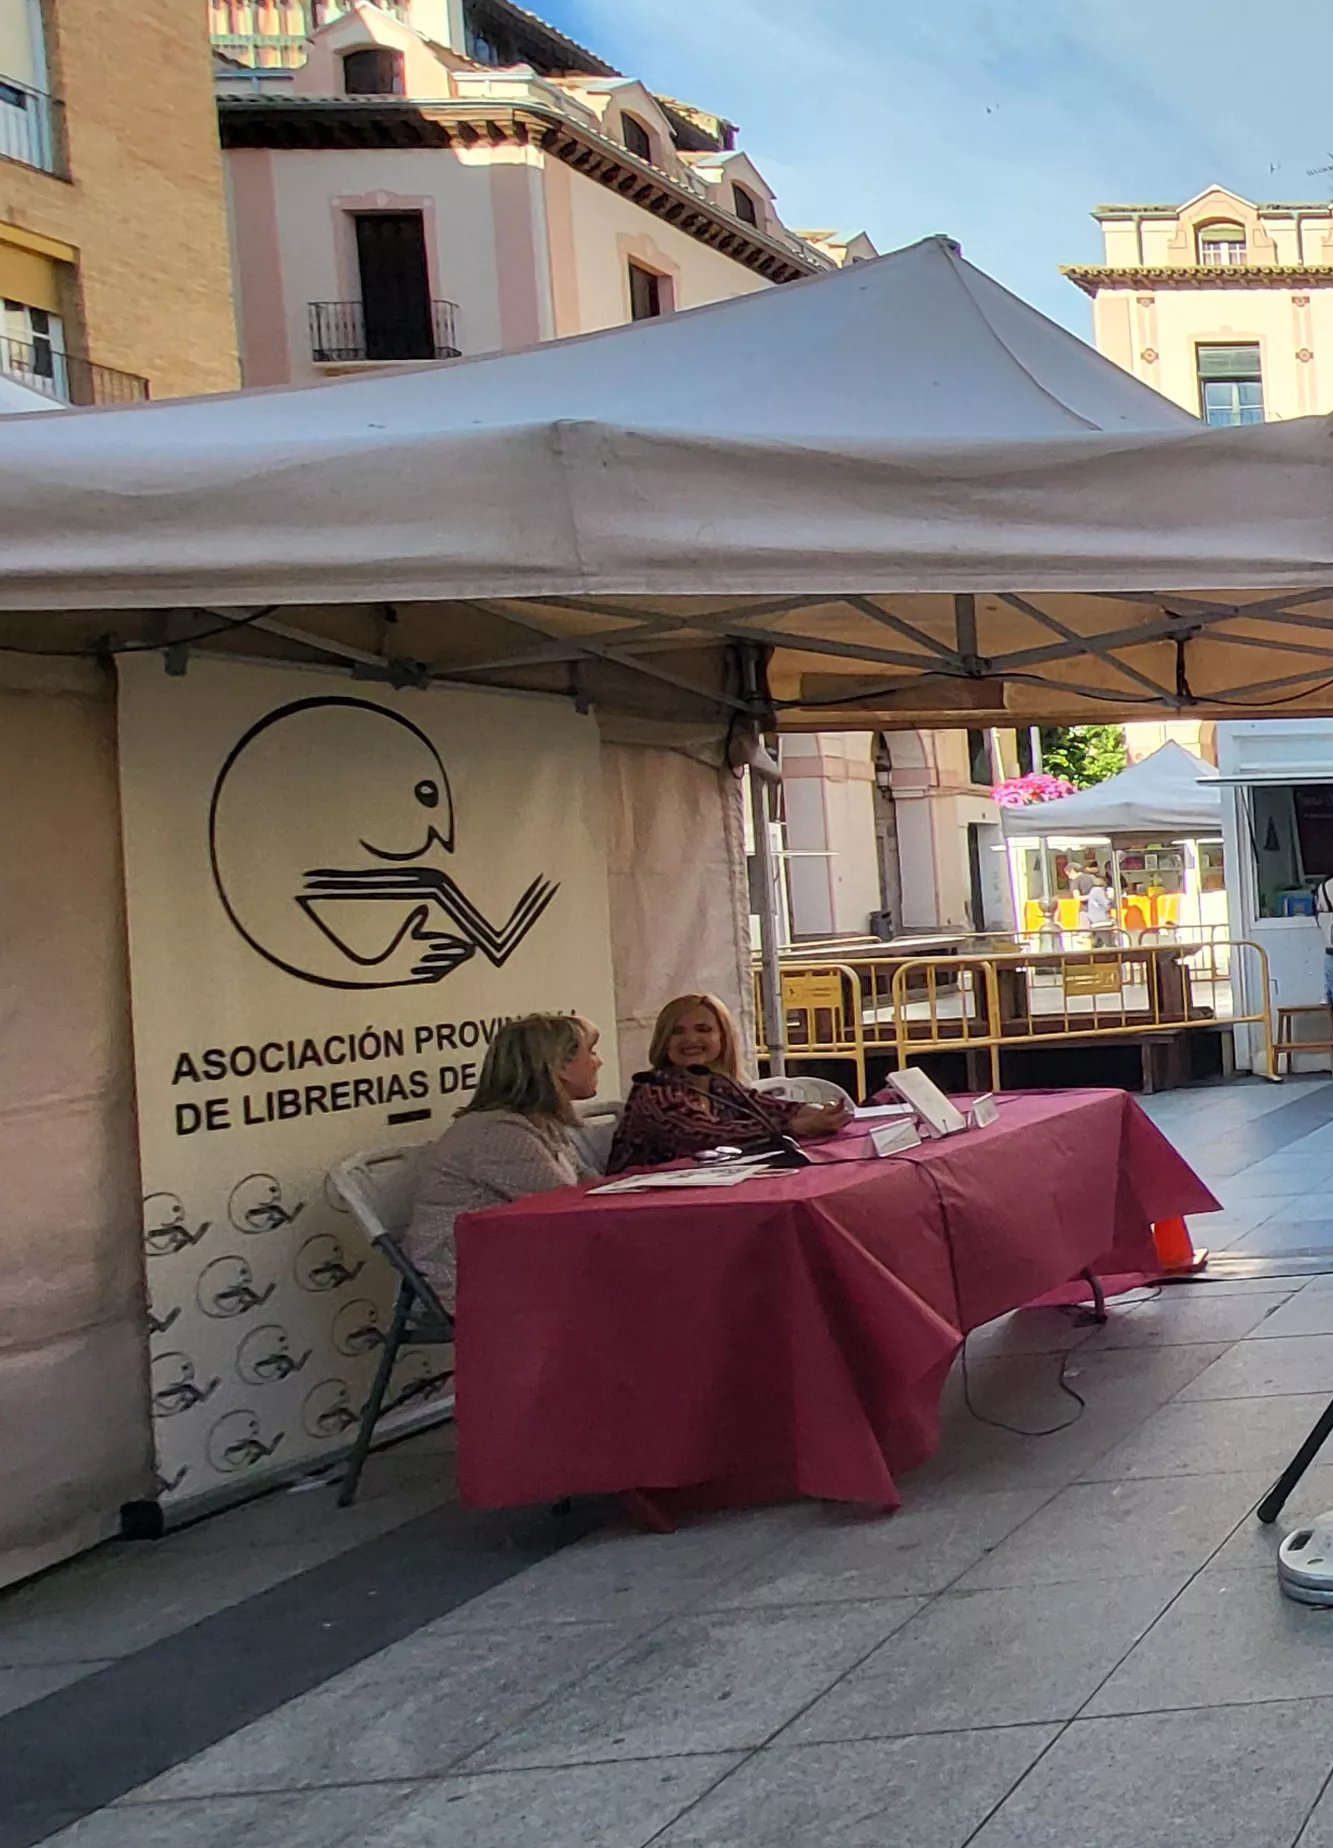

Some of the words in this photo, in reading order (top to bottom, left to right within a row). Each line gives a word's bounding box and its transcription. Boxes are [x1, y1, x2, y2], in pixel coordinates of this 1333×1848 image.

[171, 1024, 405, 1086] ASOCIACIÓN
[175, 1098, 231, 1137] DE
[243, 1070, 430, 1126] LIBRERIAS
[440, 1062, 477, 1094] DE
